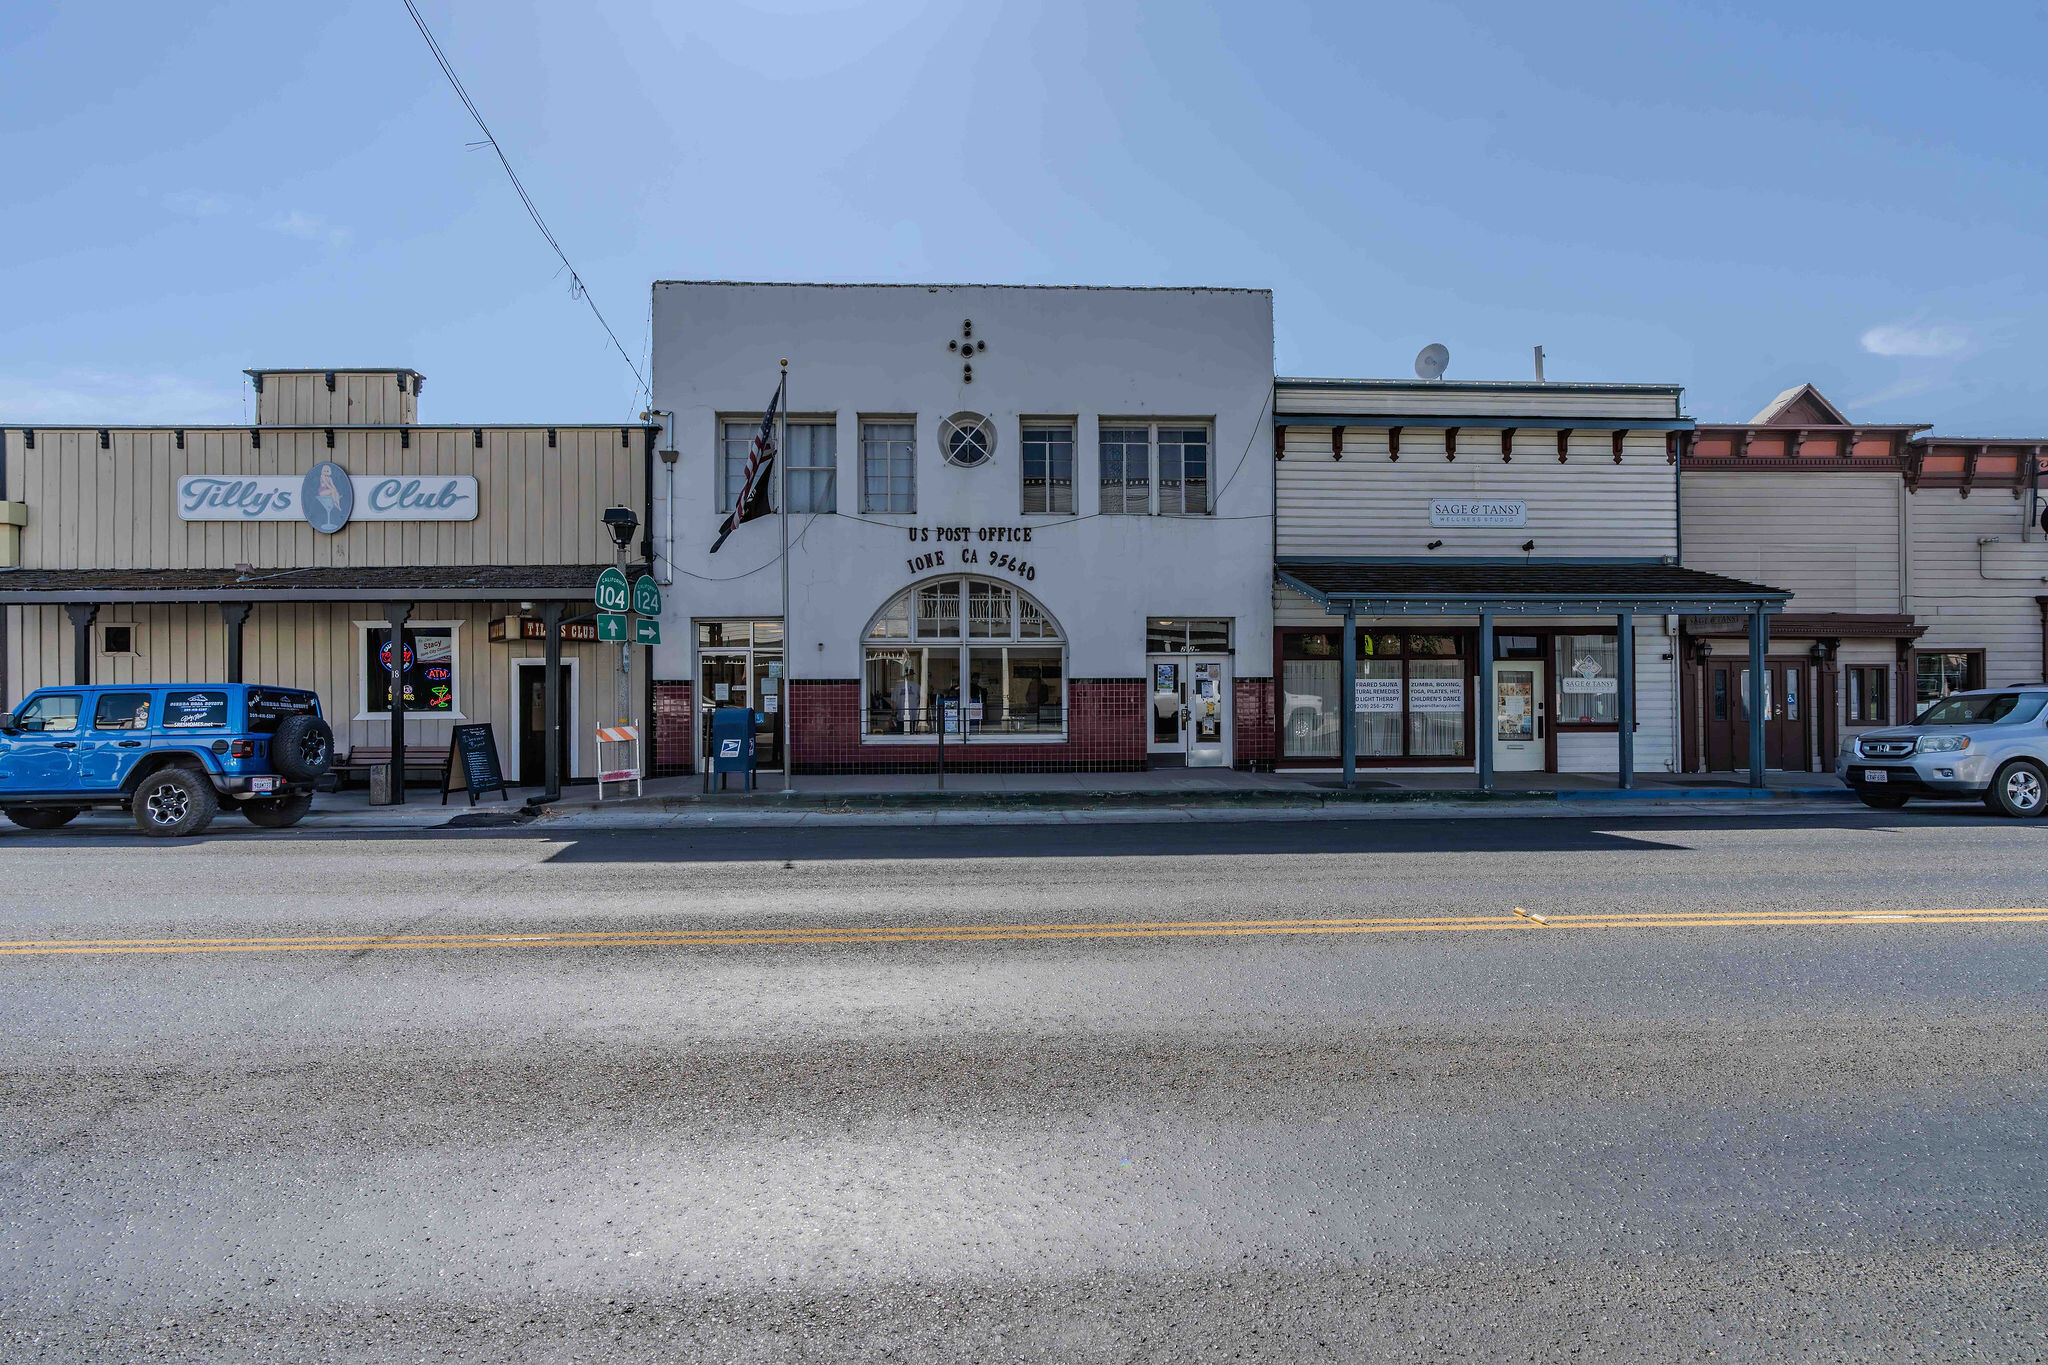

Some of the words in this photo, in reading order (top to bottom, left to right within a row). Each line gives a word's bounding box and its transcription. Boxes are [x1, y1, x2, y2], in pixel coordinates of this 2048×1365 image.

[182, 477, 292, 517] Tilly's
[370, 478, 470, 513] Club
[1435, 504, 1468, 514] SAGE
[1470, 504, 1480, 515] &
[1482, 504, 1521, 515] TANSY
[936, 527, 971, 542] POST
[978, 527, 1032, 542] OFFICE
[906, 550, 945, 574] IONE
[961, 548, 979, 564] CA
[989, 550, 1036, 581] 95640
[601, 576, 626, 588] CALIFORNIA
[599, 584, 625, 609] 104
[636, 590, 659, 612] 124
[527, 622, 567, 637] TILS
[571, 624, 595, 639] CLUB
[423, 640, 442, 650] Stacy
[392, 670, 400, 678] 18
[429, 670, 447, 678] ATM
